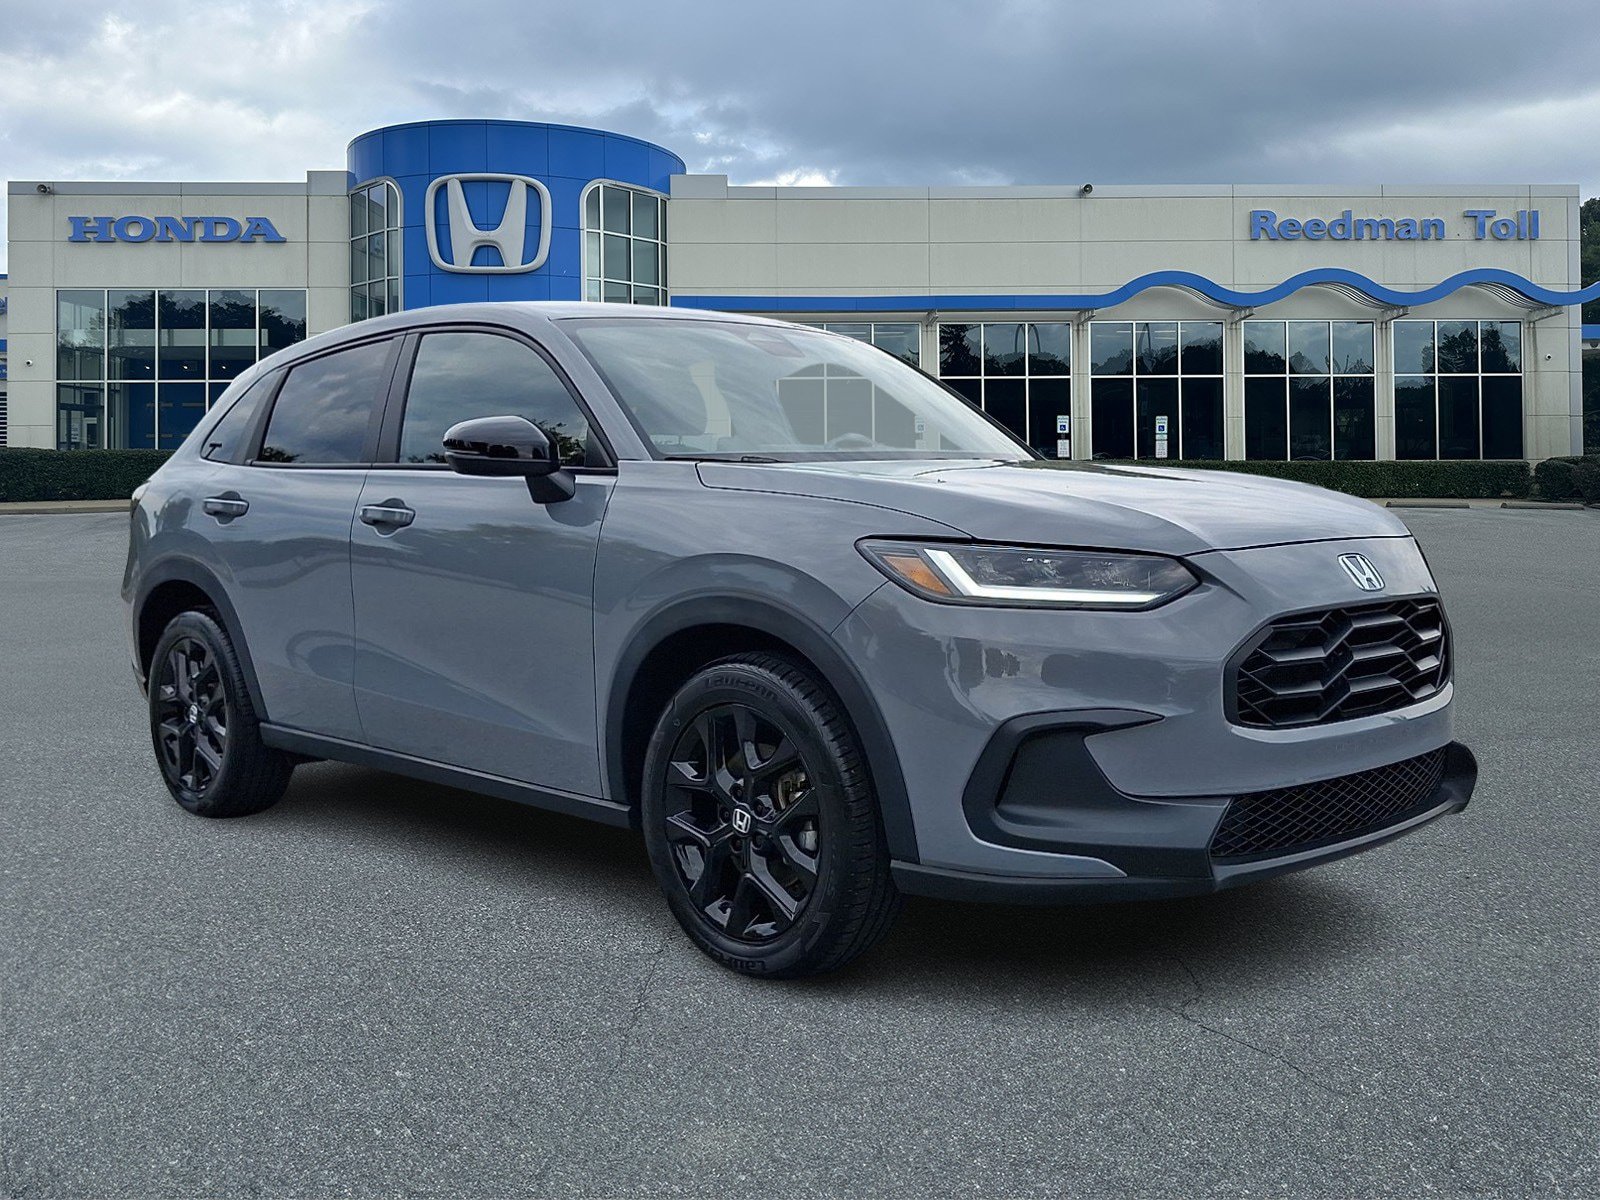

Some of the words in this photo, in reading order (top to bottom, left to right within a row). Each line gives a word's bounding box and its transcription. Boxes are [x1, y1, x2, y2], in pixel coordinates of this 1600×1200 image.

[68, 216, 287, 243] HONDA
[1250, 210, 1446, 240] Reedman
[1463, 210, 1540, 240] Toll
